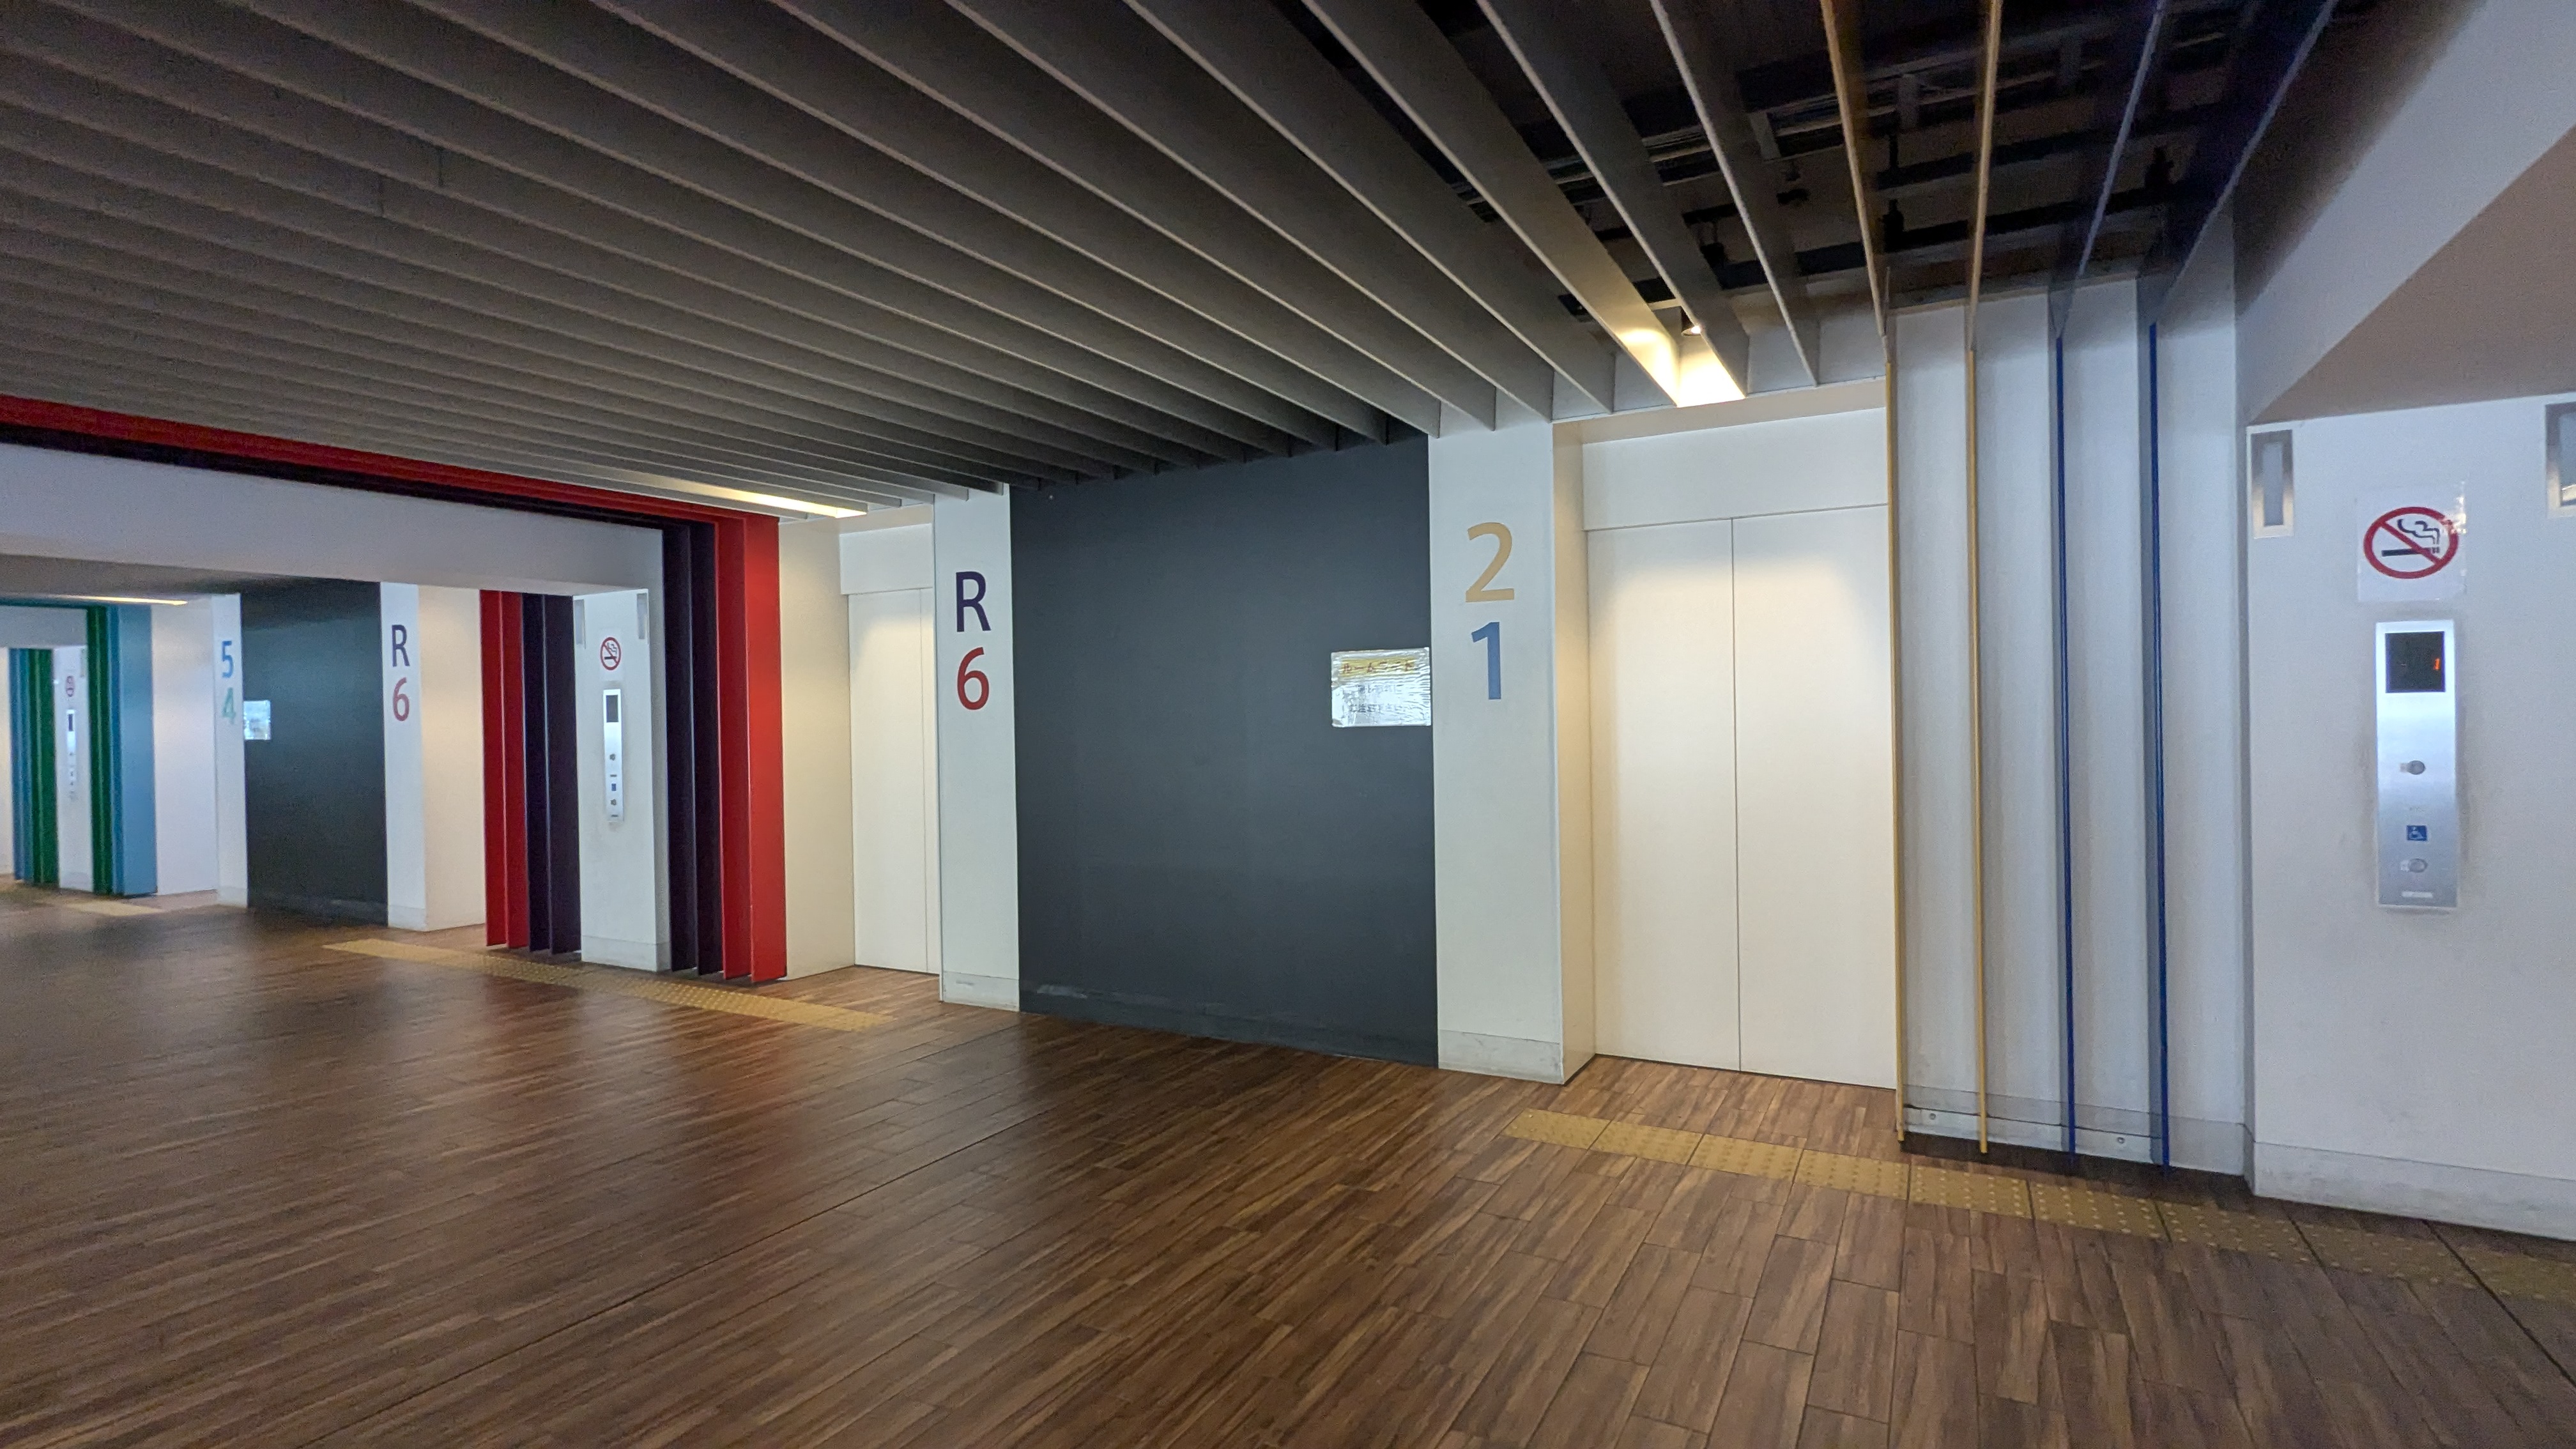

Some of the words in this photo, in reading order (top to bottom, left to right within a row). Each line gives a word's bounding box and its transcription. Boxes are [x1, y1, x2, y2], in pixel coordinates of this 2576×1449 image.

[1466, 522, 1514, 602] 2
[956, 571, 992, 632] R
[222, 640, 234, 678] 5
[392, 624, 410, 667] R
[1471, 622, 1501, 700] 1
[393, 677, 410, 721] 6
[957, 647, 989, 710] 6
[222, 687, 236, 724] 4
